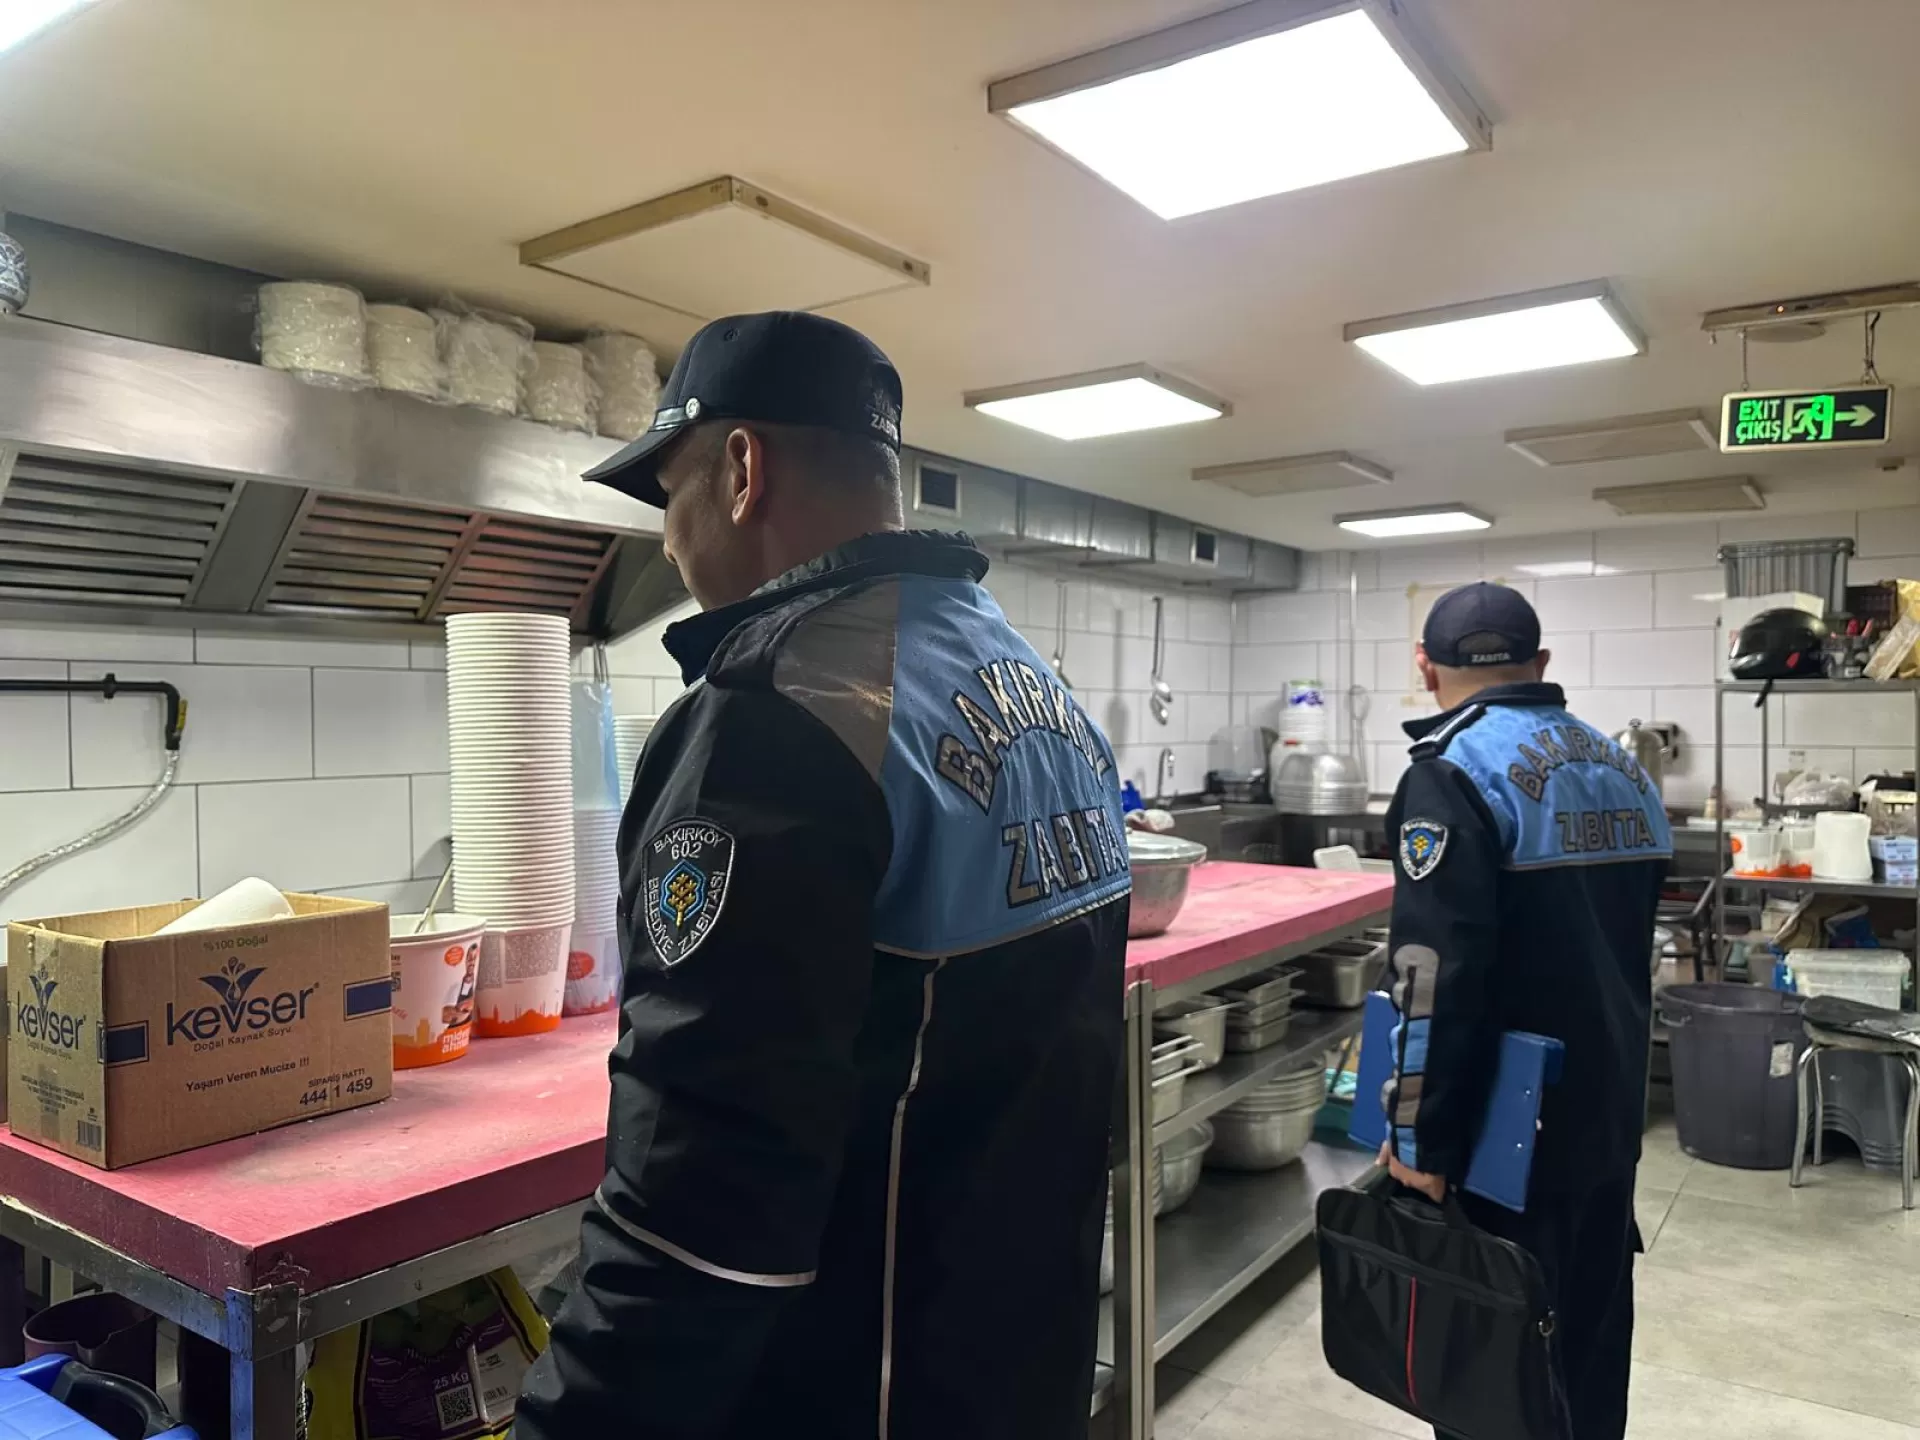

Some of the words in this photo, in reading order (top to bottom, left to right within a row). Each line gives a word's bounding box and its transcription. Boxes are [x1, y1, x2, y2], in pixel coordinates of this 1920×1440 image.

[1739, 400, 1781, 421] EXIT
[1735, 420, 1782, 444] ÇIKIŞ
[1471, 652, 1511, 664] ZABITA
[653, 827, 725, 854] BAKIRKÖY
[1554, 808, 1657, 853] ZBITA
[671, 840, 702, 860] 602
[1002, 805, 1129, 909] ZABITA
[236, 933, 268, 948] Doğal
[17, 990, 84, 1050] kevser
[166, 986, 314, 1047] kevser
[193, 1040, 224, 1053] Doğal
[227, 1030, 265, 1046] Kaynak
[267, 1025, 293, 1039] Suyu
[186, 1075, 224, 1093] Yaşam
[226, 1068, 258, 1084] Veren
[259, 1061, 296, 1077] Mucize
[342, 1067, 366, 1081] HATTI
[299, 1088, 327, 1105] 444
[334, 1084, 341, 1098] 1
[346, 1076, 373, 1095] 459
[433, 1376, 449, 1390] 25
[450, 1371, 470, 1385] Kg
